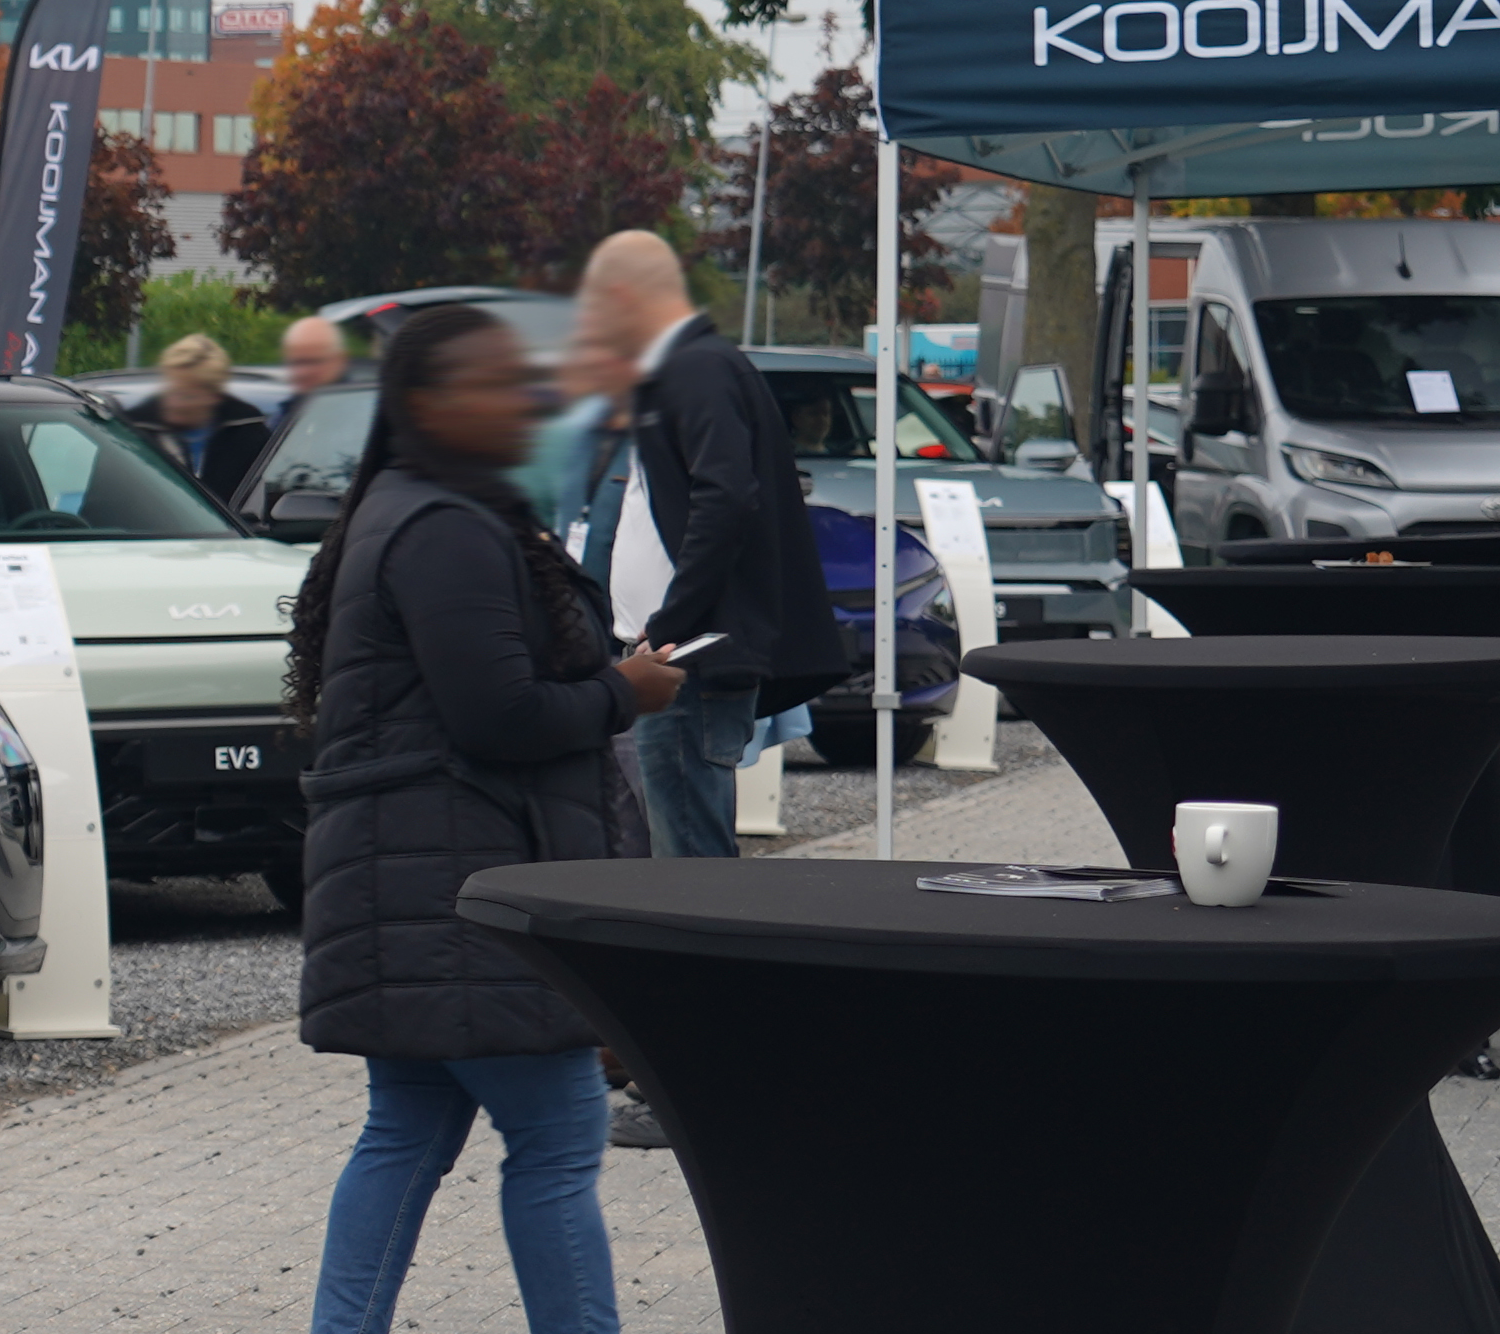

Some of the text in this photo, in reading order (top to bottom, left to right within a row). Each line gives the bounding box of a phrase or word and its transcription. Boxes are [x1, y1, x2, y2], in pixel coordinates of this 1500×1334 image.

[29, 42, 101, 72] KIA
[26, 102, 70, 325] KOOIJMAN
[215, 745, 261, 770] EV3
